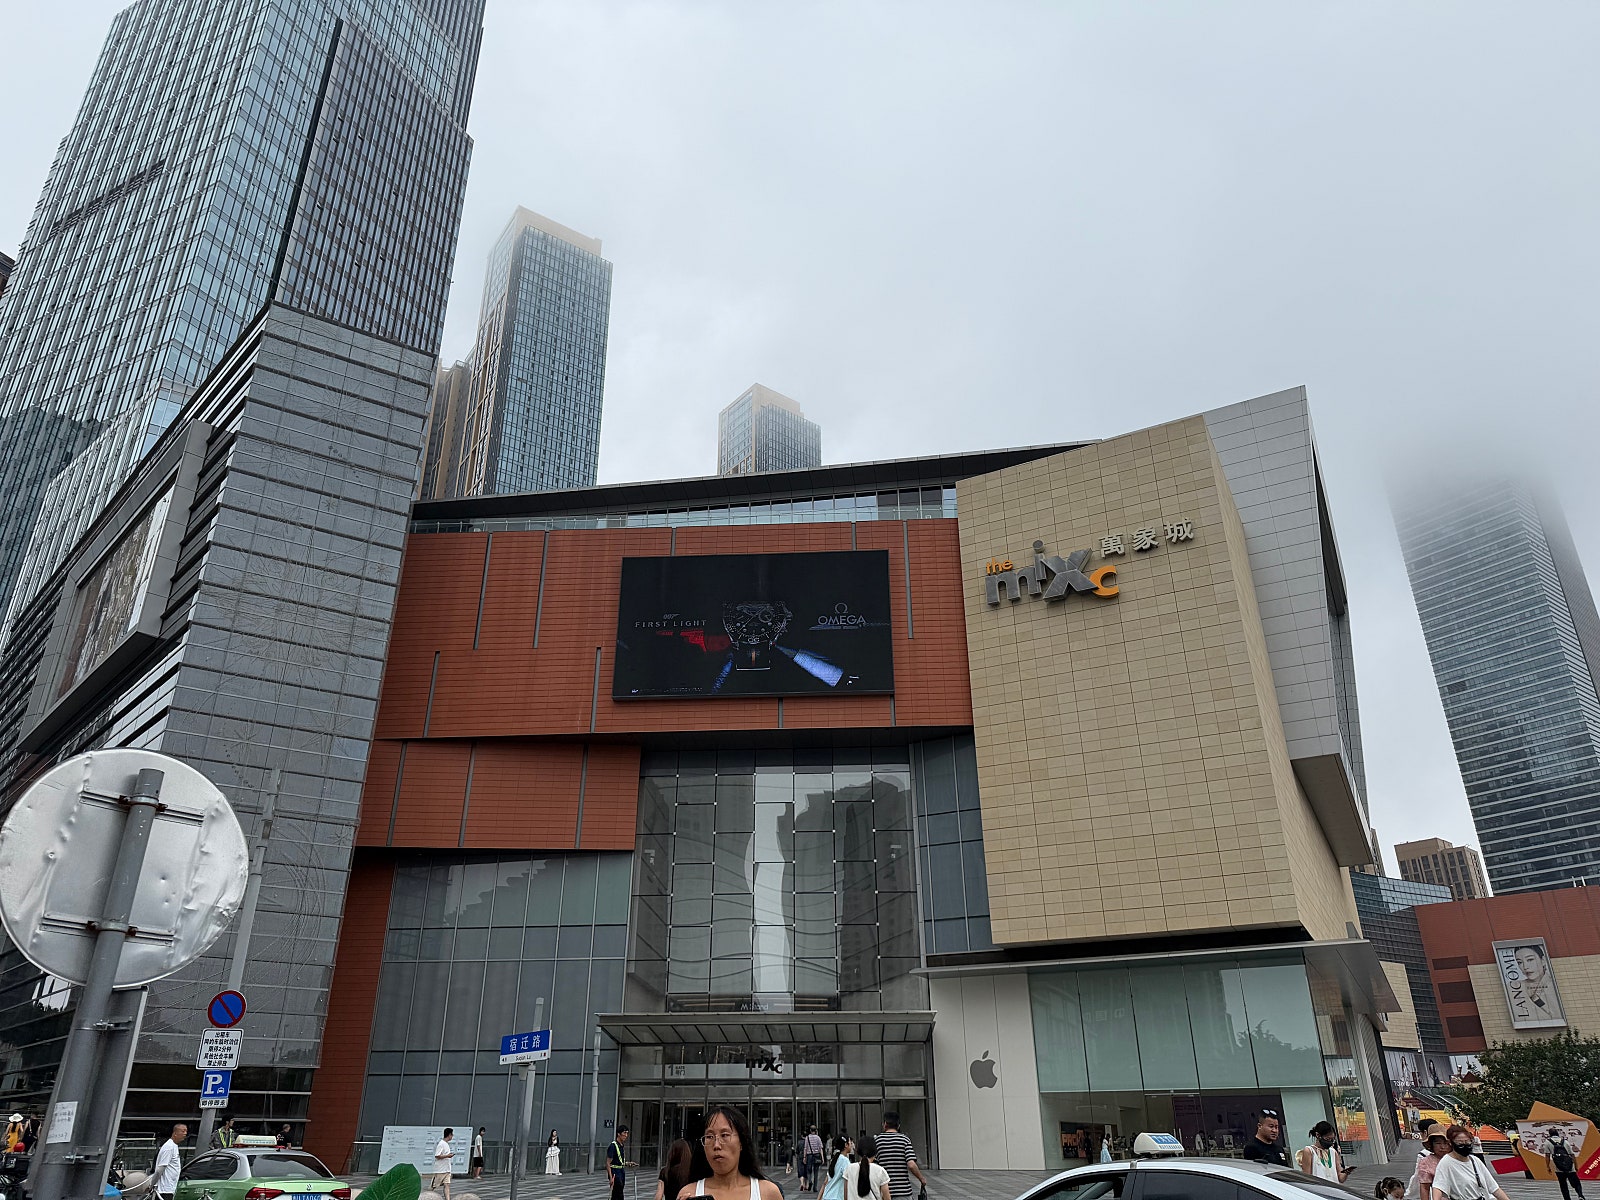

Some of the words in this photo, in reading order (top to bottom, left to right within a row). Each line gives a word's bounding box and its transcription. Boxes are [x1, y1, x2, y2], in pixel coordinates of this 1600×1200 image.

[1099, 517, 1194, 559] 萬象城
[986, 557, 1014, 575] the
[663, 613, 681, 621] 007
[673, 620, 706, 628] LIGHT
[818, 615, 866, 625] OMEGA
[510, 1034, 541, 1051] 宿迁路
[668, 1064, 674, 1076] 1
[204, 1074, 223, 1095] P
